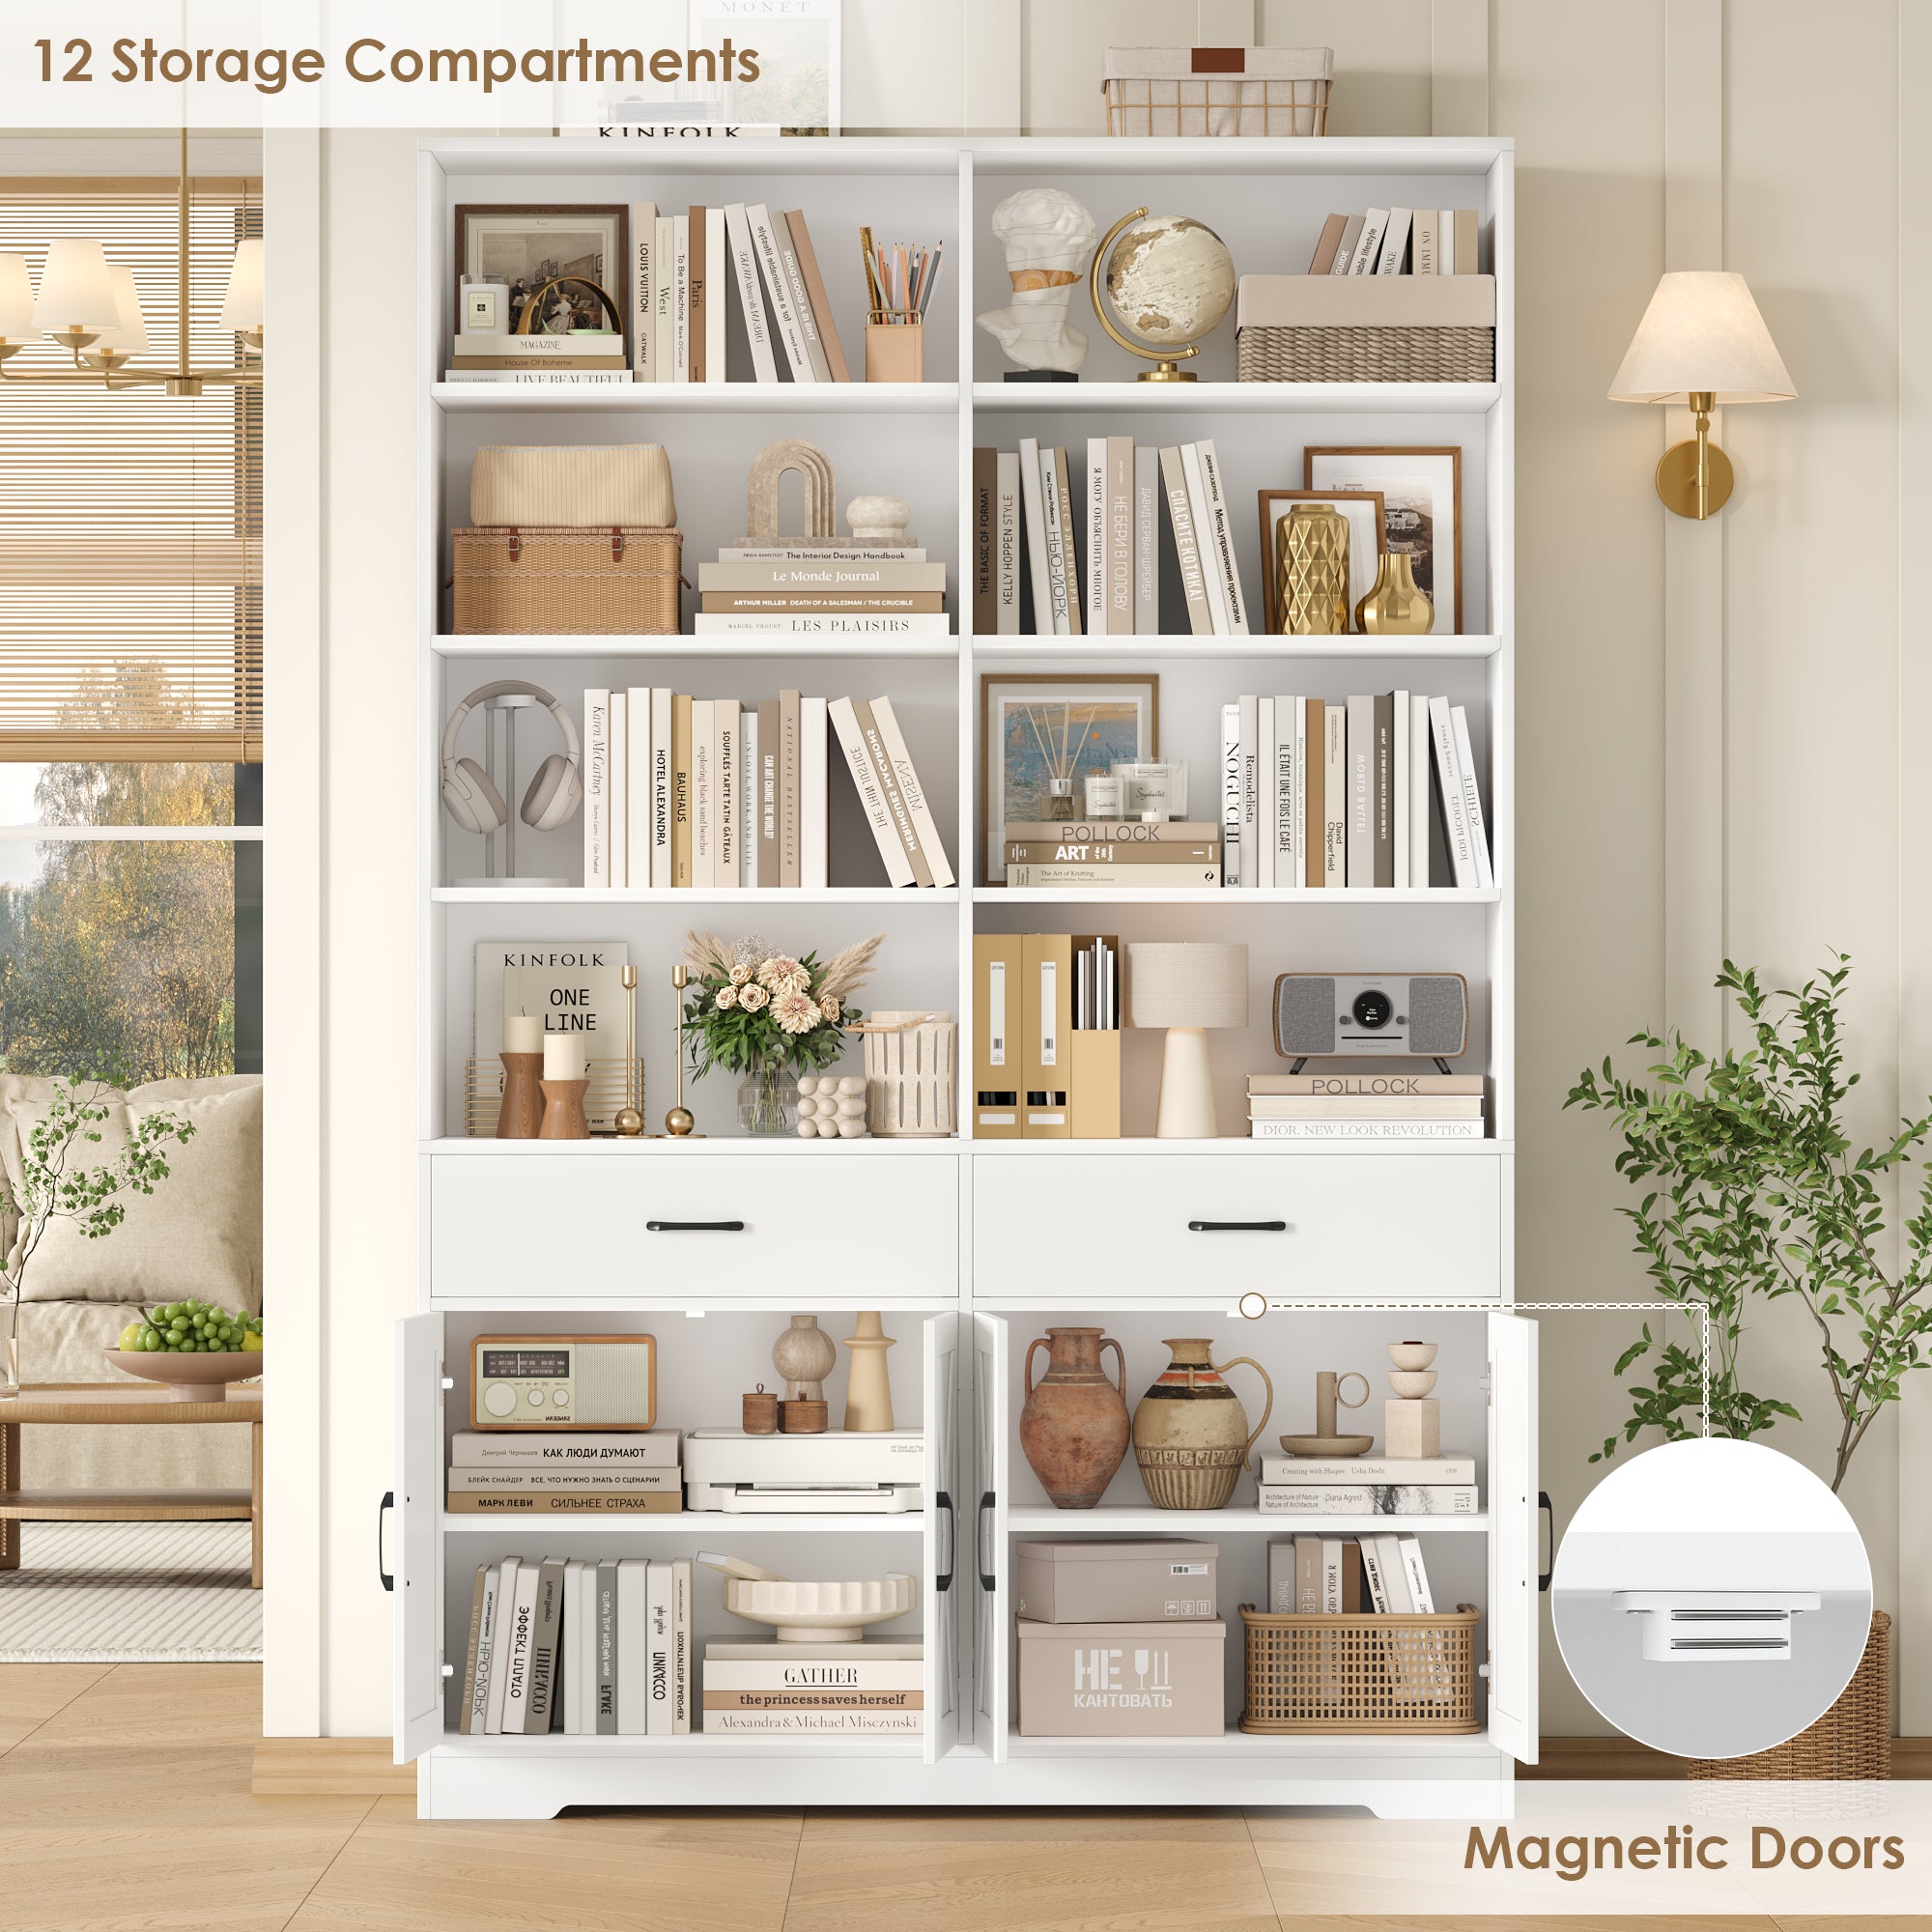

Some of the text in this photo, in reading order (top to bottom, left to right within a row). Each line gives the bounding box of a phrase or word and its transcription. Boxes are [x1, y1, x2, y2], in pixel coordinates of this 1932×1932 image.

[721, 1, 810, 14] MONET
[1361, 227, 1378, 257] lifestyle
[1421, 231, 1431, 245] ON
[639, 242, 649, 271] LOUIS
[677, 254, 686, 265] To
[1335, 250, 1350, 275] GUIDE
[677, 266, 686, 277] Be
[639, 273, 649, 314] VUITTON
[659, 286, 670, 316] West
[677, 287, 686, 322] Machine
[692, 279, 703, 309] Paris
[520, 340, 561, 351] MAGAZINE
[505, 358, 529, 367] House
[542, 358, 573, 367] Boheme
[980, 487, 990, 595] THE BASIC OF FORMAT
[1003, 494, 1013, 605] KELLY HOPPEN STYLE
[1094, 477, 1102, 611] МОГУ ОБЪЯСНИТЬ МНОГОЕ
[1114, 496, 1128, 611] НЕ БЕРИ В ГОЛОВУ
[1141, 487, 1151, 602] ДАВИД СЕРВАН-ШРЕЙБЕР
[1170, 489, 1204, 603] СПАСИТЕ КОТИКА!
[833, 552, 862, 561] Design
[1065, 526, 1078, 605] ЭЛЛЕНХОРН
[1214, 508, 1241, 624] Метод проектами
[772, 571, 880, 583] Le Monde Journal
[1049, 531, 1067, 619] НЬЮ-ЙОРК
[791, 620, 910, 632] LES PLAISIRS
[589, 706, 605, 796] Karen McCartney
[723, 730, 732, 770] SOUFFLÉS
[656, 750, 666, 846] HOTEL ALEXANDRA
[677, 772, 686, 822] BAUHAUS
[697, 746, 708, 856] exploring black sand beaches
[764, 754, 774, 839] CAN CHANGE THE WORLD?
[1226, 742, 1239, 844] NOGUCHI
[1245, 754, 1256, 824] Remodelista
[1279, 744, 1292, 853] IL ÉTAIT UNE FOIS LE CAFÉ
[723, 826, 732, 865] GÂTEAUX
[1062, 825, 1160, 842] POLLOCK
[1326, 822, 1335, 871] Chipperfield
[1055, 845, 1090, 861] ART
[504, 953, 606, 967] KINFOLK
[550, 988, 590, 1006] ONE
[545, 1013, 597, 1031] LINE
[1311, 1078, 1420, 1094] POLLOCK
[1264, 1125, 1472, 1136] DIOR. NEW LOOK REVOLUTION
[481, 1449, 646, 1459] Дмитрий КАК ЛЮДИ ДУМАЮТ
[1282, 1467, 1308, 1477] Creating
[478, 1498, 646, 1508] МАРК ЛЕВИ СИЛЬНЕЕ СТРАХА
[1324, 1493, 1342, 1502] Diana
[1343, 1493, 1363, 1503] Agrest
[784, 1667, 858, 1684] GATHER
[1074, 1649, 1122, 1690] НЕ
[739, 1694, 906, 1707] the princess saves herself
[1074, 1693, 1173, 1708] КАНТОВАТЬ
[719, 1716, 918, 1731] Alexandra & Michael Misczynski
